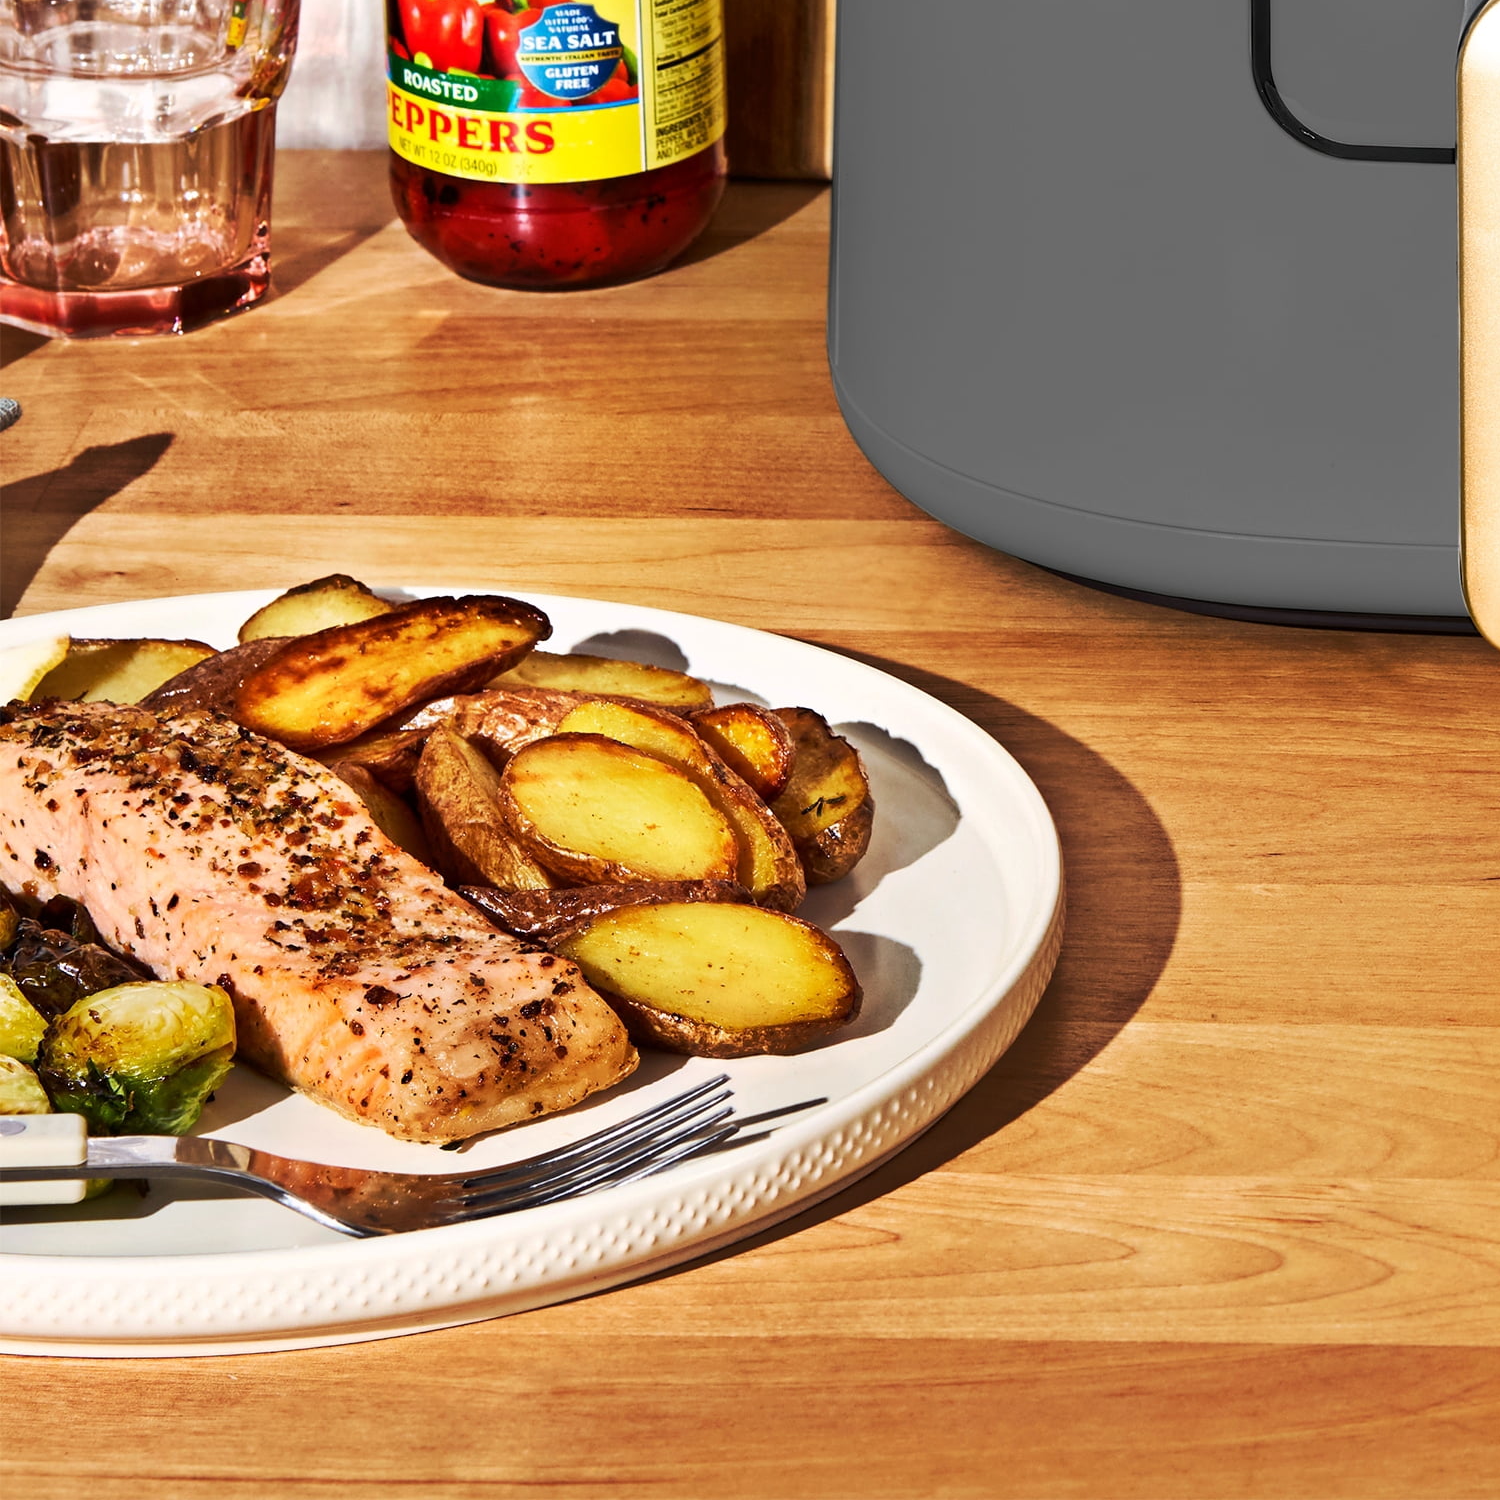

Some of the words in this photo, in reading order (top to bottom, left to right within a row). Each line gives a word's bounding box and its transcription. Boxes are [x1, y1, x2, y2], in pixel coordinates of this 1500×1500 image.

[523, 35, 562, 51] SEA
[567, 31, 615, 49] SALT
[544, 64, 599, 78] GLUTEN
[403, 68, 479, 103] ROASTED
[555, 77, 590, 90] FREE
[399, 136, 411, 152] NET
[413, 143, 426, 157] WT
[430, 149, 440, 164] 12
[443, 153, 457, 169] OZ
[460, 156, 498, 177] (340g)
